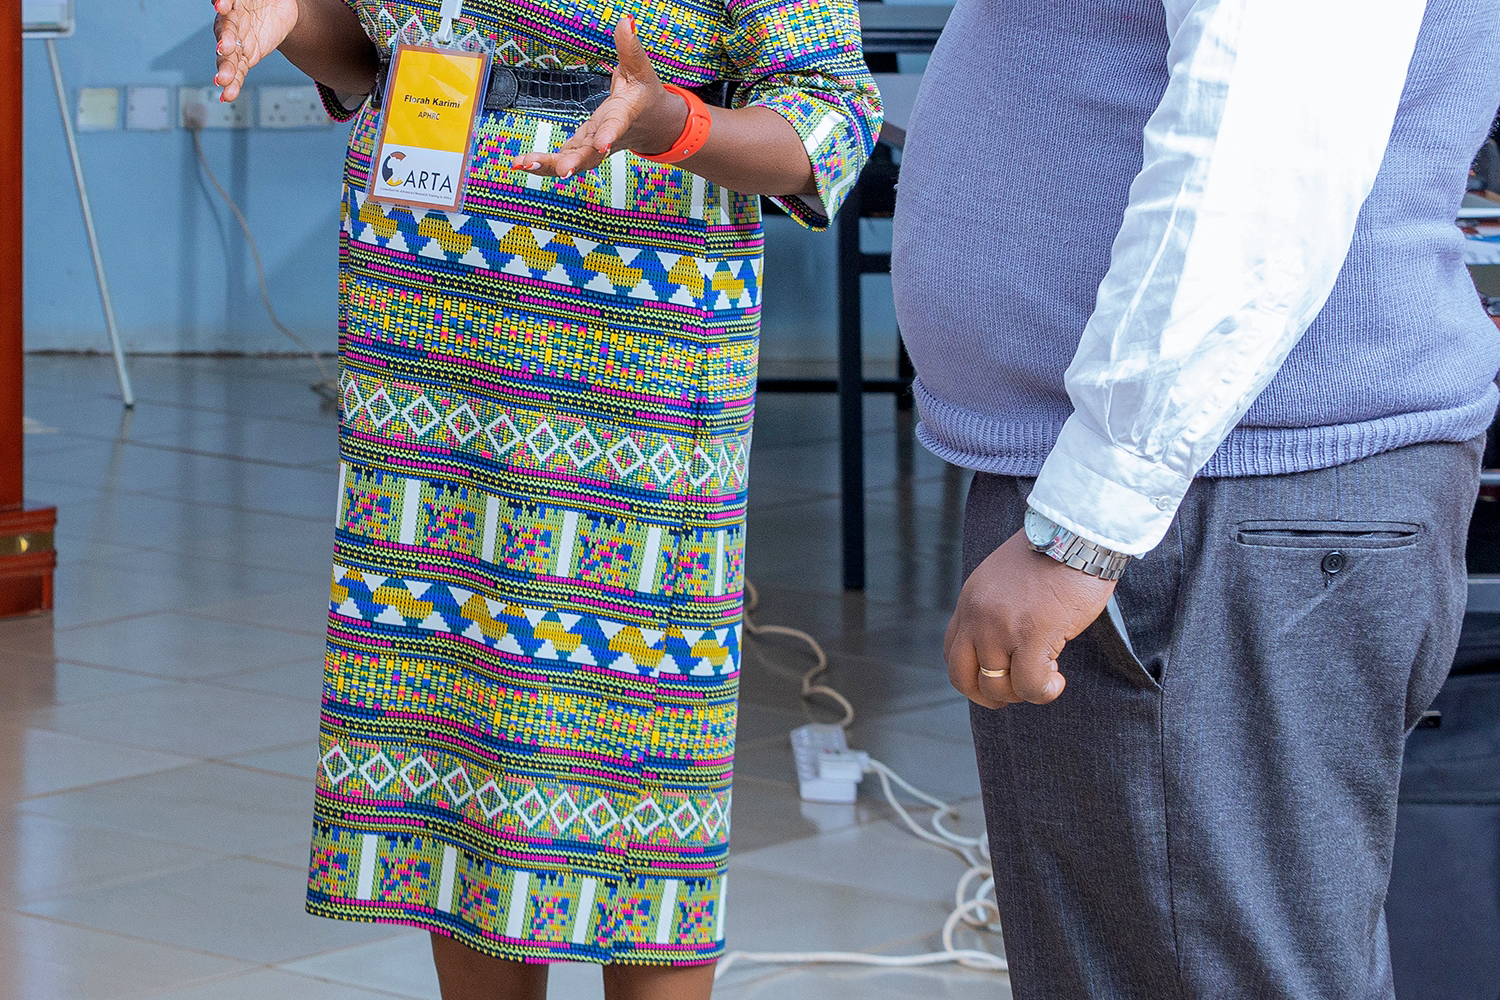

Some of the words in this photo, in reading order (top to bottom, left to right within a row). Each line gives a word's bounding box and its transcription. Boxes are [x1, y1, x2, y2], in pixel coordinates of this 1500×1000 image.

[404, 94, 430, 106] Florah
[432, 98, 460, 109] Karimi
[418, 112, 440, 121] APHRC
[382, 151, 452, 193] CARTA
